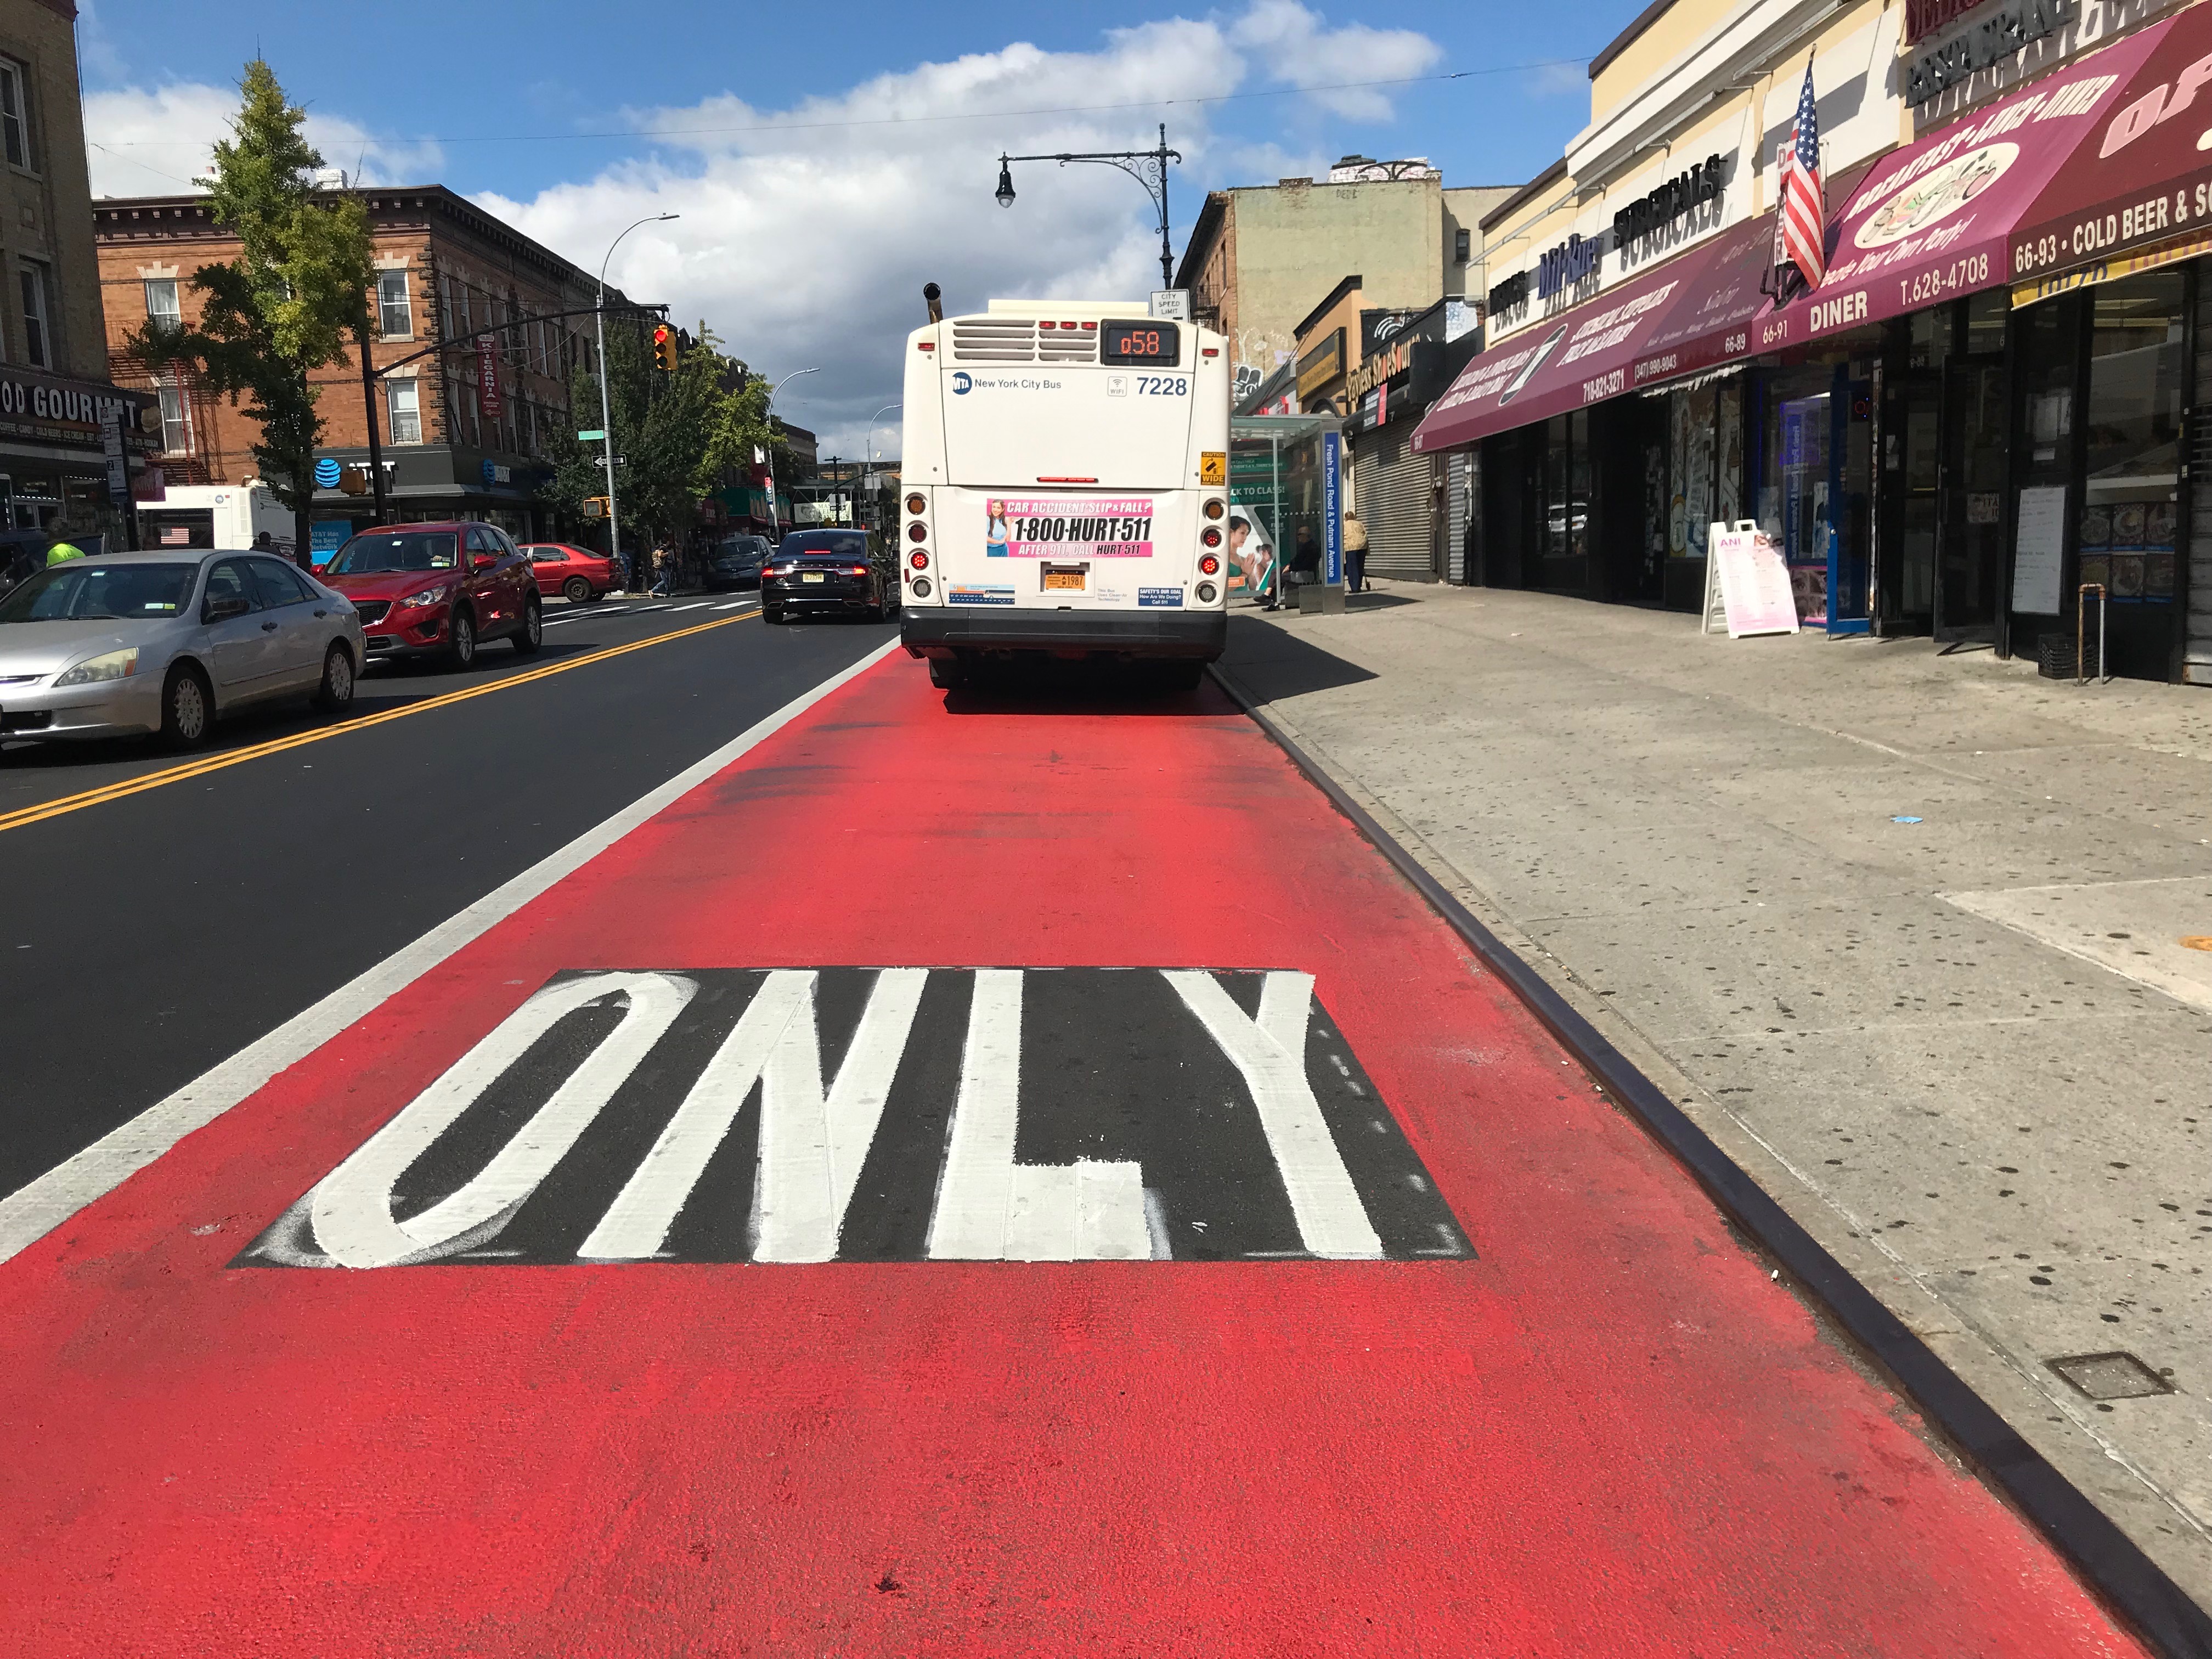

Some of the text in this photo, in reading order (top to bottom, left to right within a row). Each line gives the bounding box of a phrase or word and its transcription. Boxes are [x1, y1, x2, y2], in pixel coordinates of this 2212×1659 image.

[1844, 74, 2119, 223] BREAKFAST LUNCH DINNER
[2015, 234, 2056, 273] 66-93
[2073, 215, 2117, 256] COLD
[2122, 196, 2168, 241] BEER
[2175, 189, 2188, 221] &
[1852, 251, 1890, 276] Your
[1884, 238, 1923, 266] Own
[1810, 291, 1867, 332] DINER
[1725, 333, 1746, 353] 66-89
[1763, 320, 1787, 345] 66-91
[1373, 333, 1420, 386] ShoeSour
[952, 376, 1061, 391] MTA New York City Bus
[1137, 377, 1187, 396] 7228
[33, 386, 136, 428] GOURMT
[1007, 502, 1029, 513] CAR
[1120, 502, 1151, 513] FALL?
[1018, 544, 1048, 555] AFTER
[1072, 544, 1094, 555] CALL
[1720, 538, 1741, 547] ANI
[1068, 575, 1083, 586] 1987
[312, 968, 1383, 1268] ONLY
